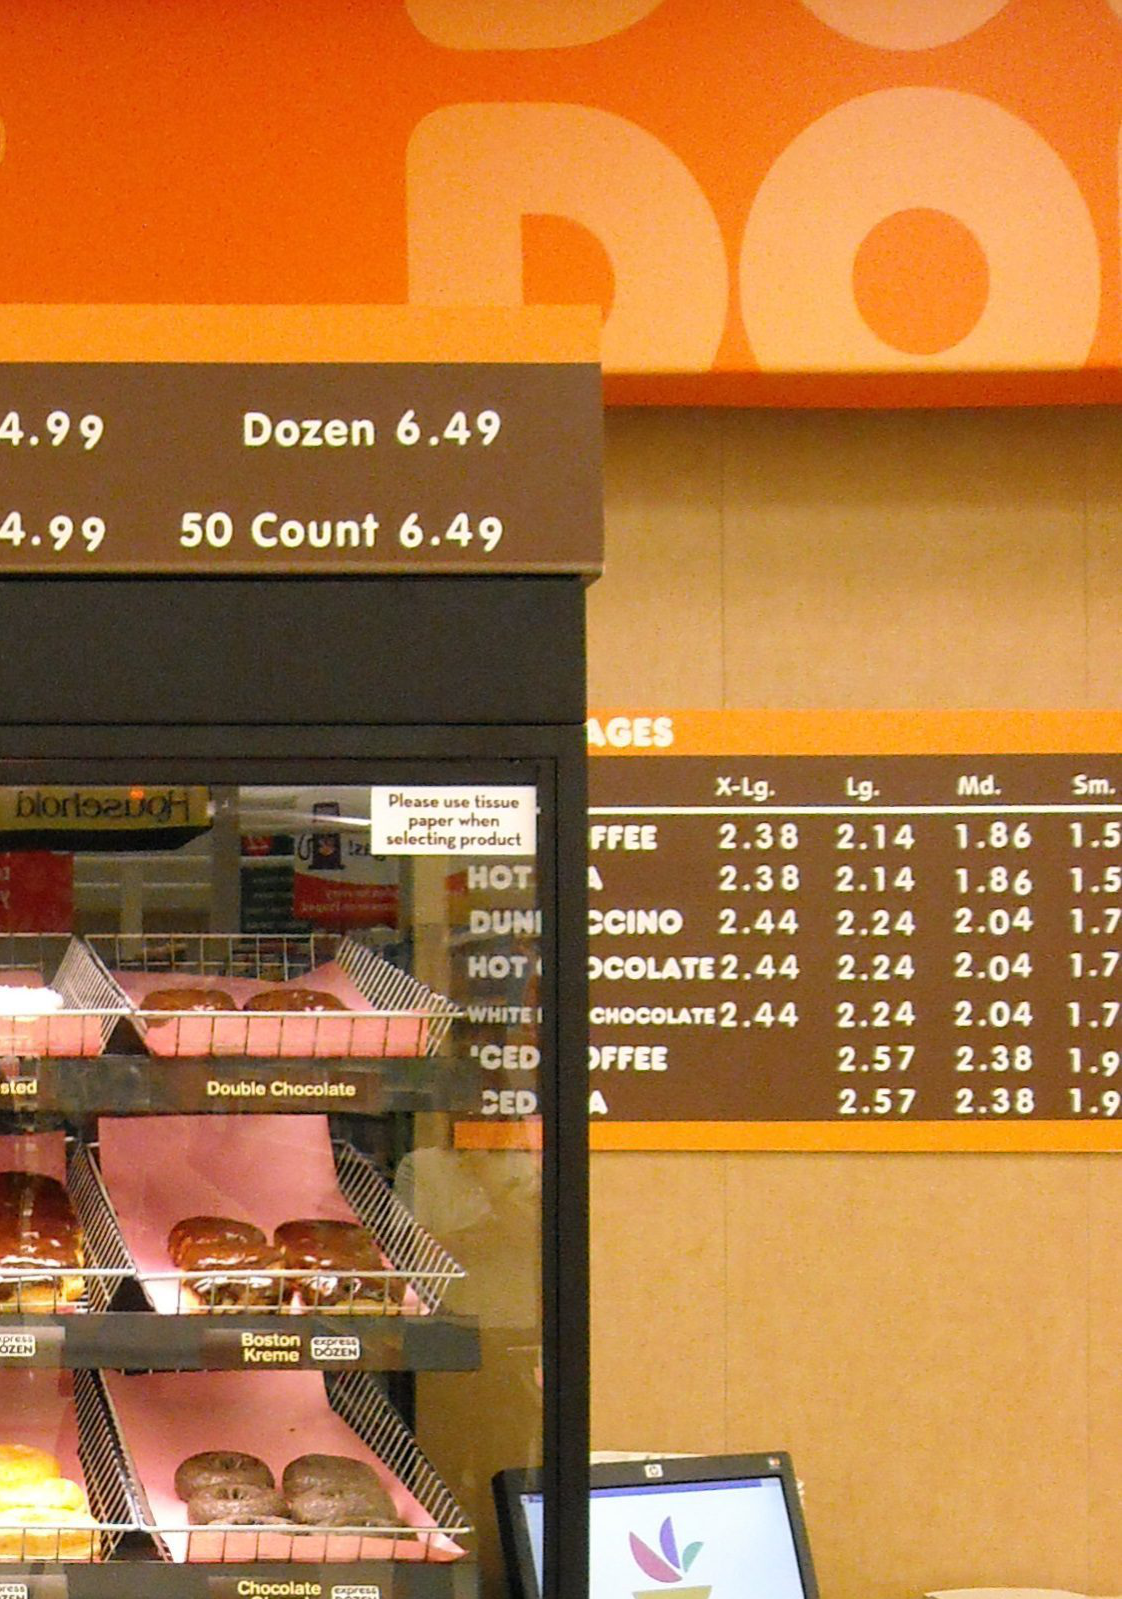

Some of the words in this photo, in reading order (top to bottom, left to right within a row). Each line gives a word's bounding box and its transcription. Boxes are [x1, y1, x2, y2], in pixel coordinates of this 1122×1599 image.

[244, 411, 375, 447] Dozen
[396, 409, 501, 446] 6.49
[180, 511, 233, 548] 50
[251, 511, 379, 548] Count
[399, 512, 503, 552] 6.49
[715, 776, 776, 802] X-Lg.
[847, 776, 880, 802] Lg.
[957, 774, 1002, 796] Md.
[1073, 774, 1116, 795] Sm.
[388, 793, 439, 809] Please
[443, 798, 470, 809] use
[474, 795, 520, 809] tissue
[408, 817, 454, 831] paper
[458, 812, 500, 827] when
[386, 830, 457, 850] selecting
[460, 831, 522, 850] product
[590, 824, 658, 850] FFEE
[719, 822, 799, 850] 2.38
[836, 823, 916, 850] 2.14
[955, 821, 1032, 849] 1.86
[1070, 821, 1121, 848] 1.5
[467, 864, 533, 892] HOT
[719, 864, 800, 892] 2.38
[836, 865, 915, 892] 2.14
[956, 866, 1033, 896] 1.86
[1070, 866, 1122, 893] 1.5
[719, 908, 799, 935] 2.44
[837, 909, 916, 936] 2.24
[955, 906, 1034, 936] 2.04
[1071, 907, 1122, 934] 1.7
[467, 954, 528, 981] HOT
[720, 954, 800, 980] 2.44
[838, 954, 915, 981] 2.24
[955, 951, 1033, 982] 2.04
[1070, 951, 1120, 978] 1.7
[466, 1005, 533, 1026] WHITE
[589, 1006, 716, 1025] CHOCOLATE
[720, 1001, 799, 1028] 2.44
[837, 1000, 916, 1028] 2.24
[955, 1000, 1034, 1028] 2.04
[1068, 1001, 1121, 1028] 1.7
[838, 1045, 915, 1072] 2.57
[956, 1045, 1033, 1072] 2.38
[1069, 1047, 1121, 1077] 1.9
[206, 1080, 266, 1096] Double
[270, 1080, 356, 1096] Chocolate
[478, 1088, 538, 1115] CED
[839, 1088, 917, 1114] 2.57
[956, 1087, 1035, 1114] 2.38
[1070, 1087, 1121, 1117] 1.9
[240, 1331, 301, 1347] Boston
[314, 1338, 358, 1347] express
[244, 1347, 300, 1363] Kreme
[315, 1347, 358, 1357] DOZEN
[237, 1580, 322, 1596] Chocolate
[334, 1587, 377, 1595] express
